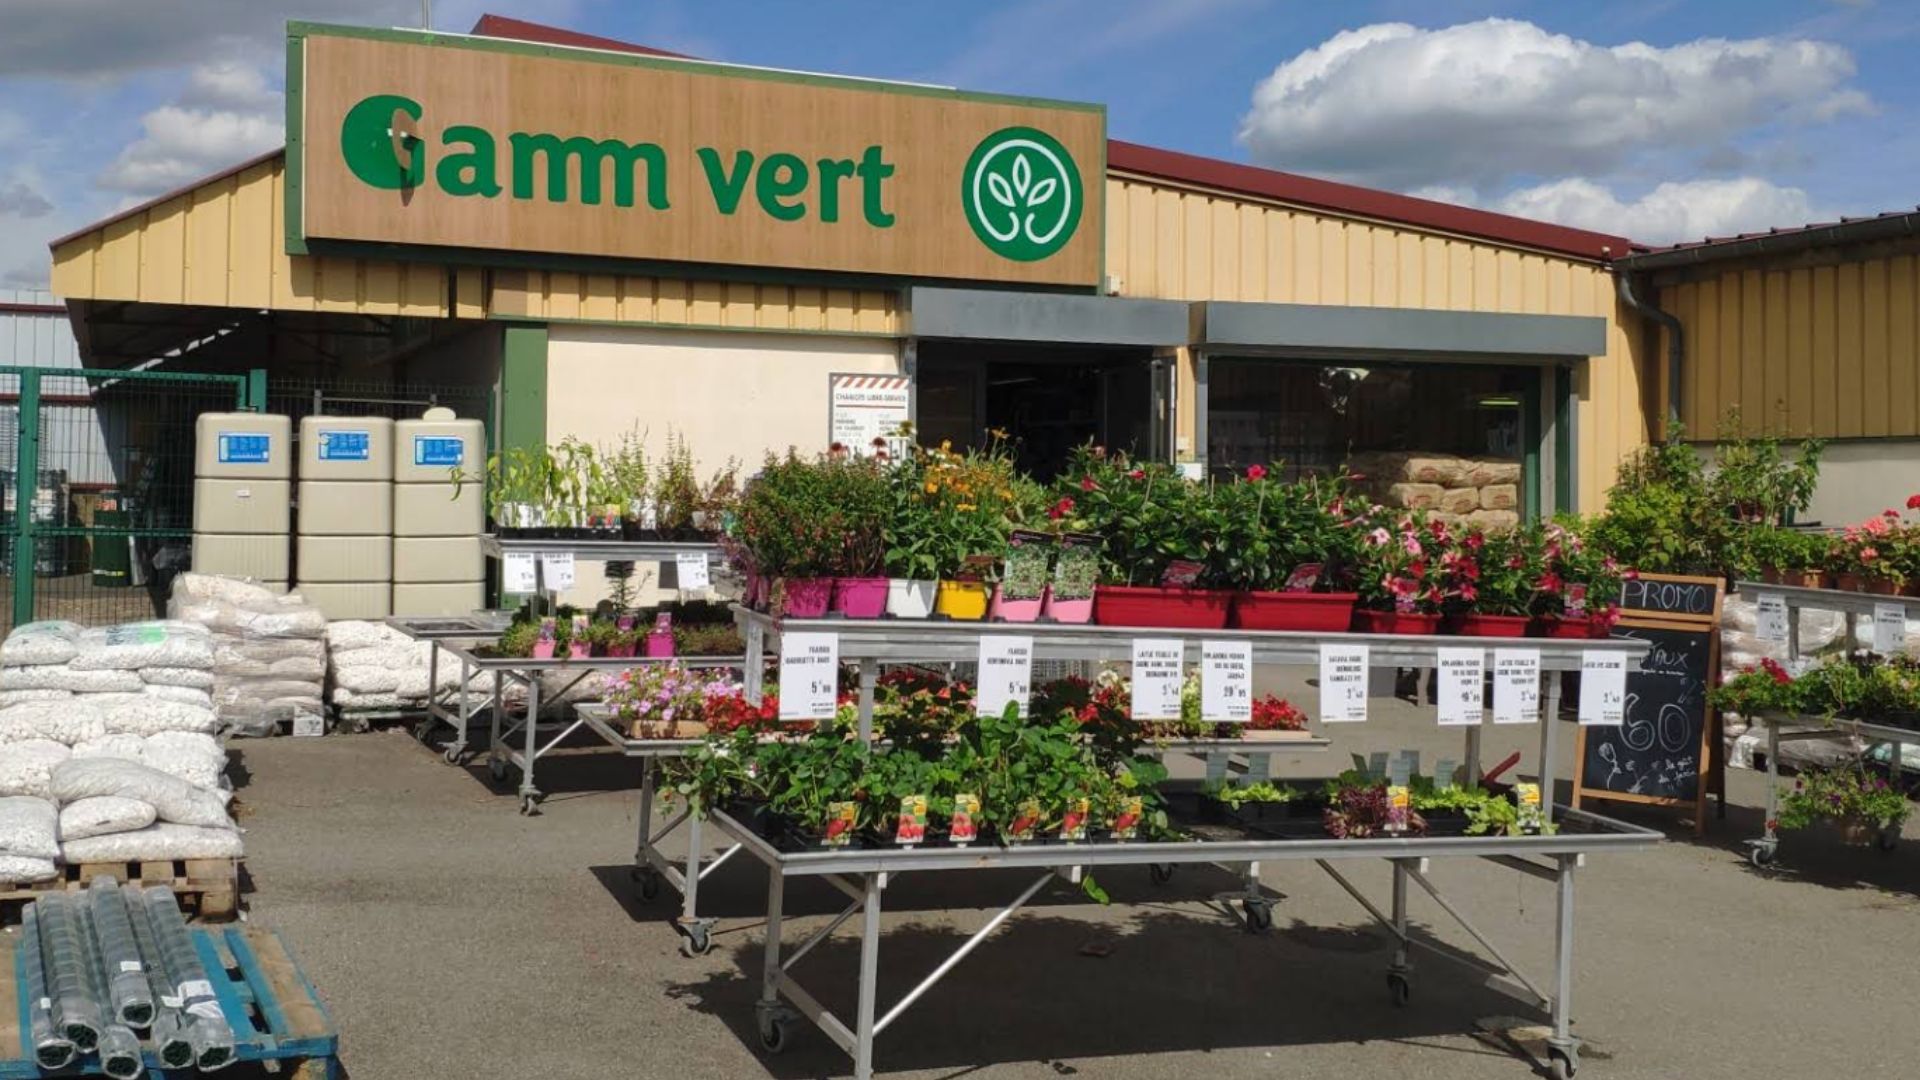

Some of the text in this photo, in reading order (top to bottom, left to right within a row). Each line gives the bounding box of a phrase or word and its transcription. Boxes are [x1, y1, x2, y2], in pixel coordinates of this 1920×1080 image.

[341, 95, 895, 228] Gamm vert
[1619, 580, 1707, 613] PROMO
